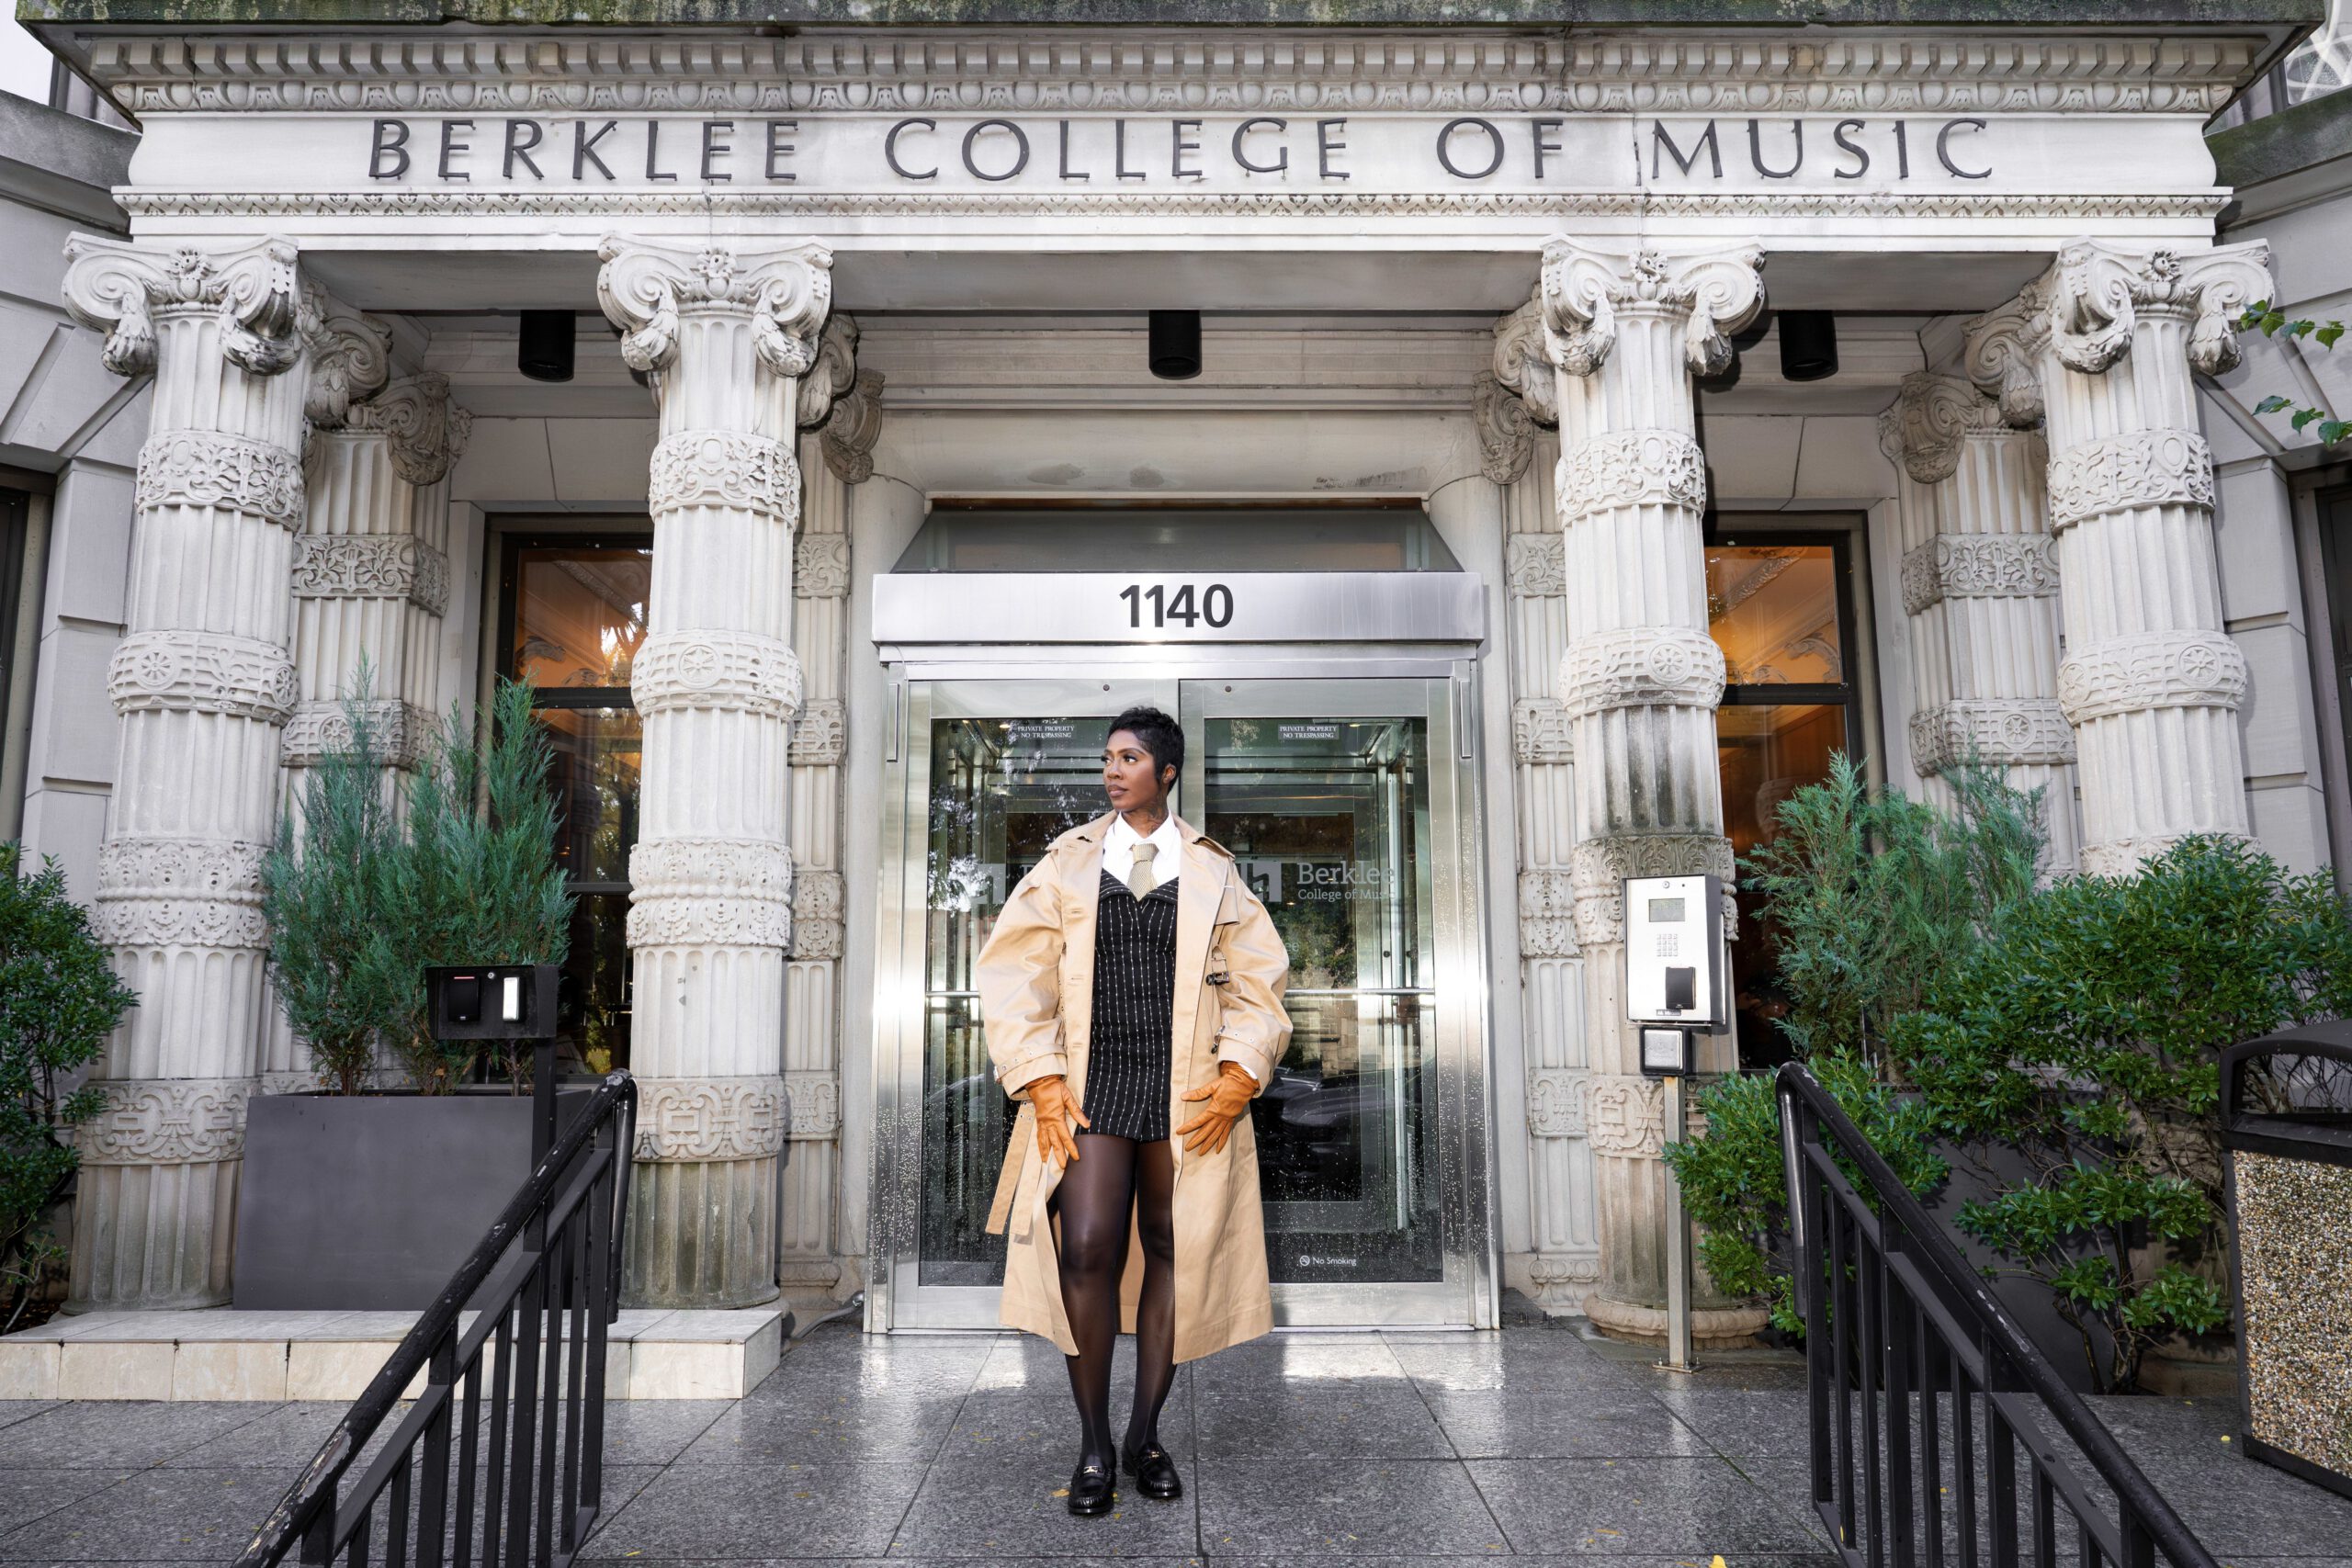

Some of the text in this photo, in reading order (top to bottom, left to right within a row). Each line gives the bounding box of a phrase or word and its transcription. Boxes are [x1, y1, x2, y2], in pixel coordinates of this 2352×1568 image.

[369, 118, 1993, 182] BERKLEE COLLEGE OF MUSIC
[1119, 583, 1234, 628] 1140
[1296, 860, 1396, 885] Berklee
[1297, 888, 1396, 902] College of Musc
[1312, 1257, 1357, 1266] No Smoking
